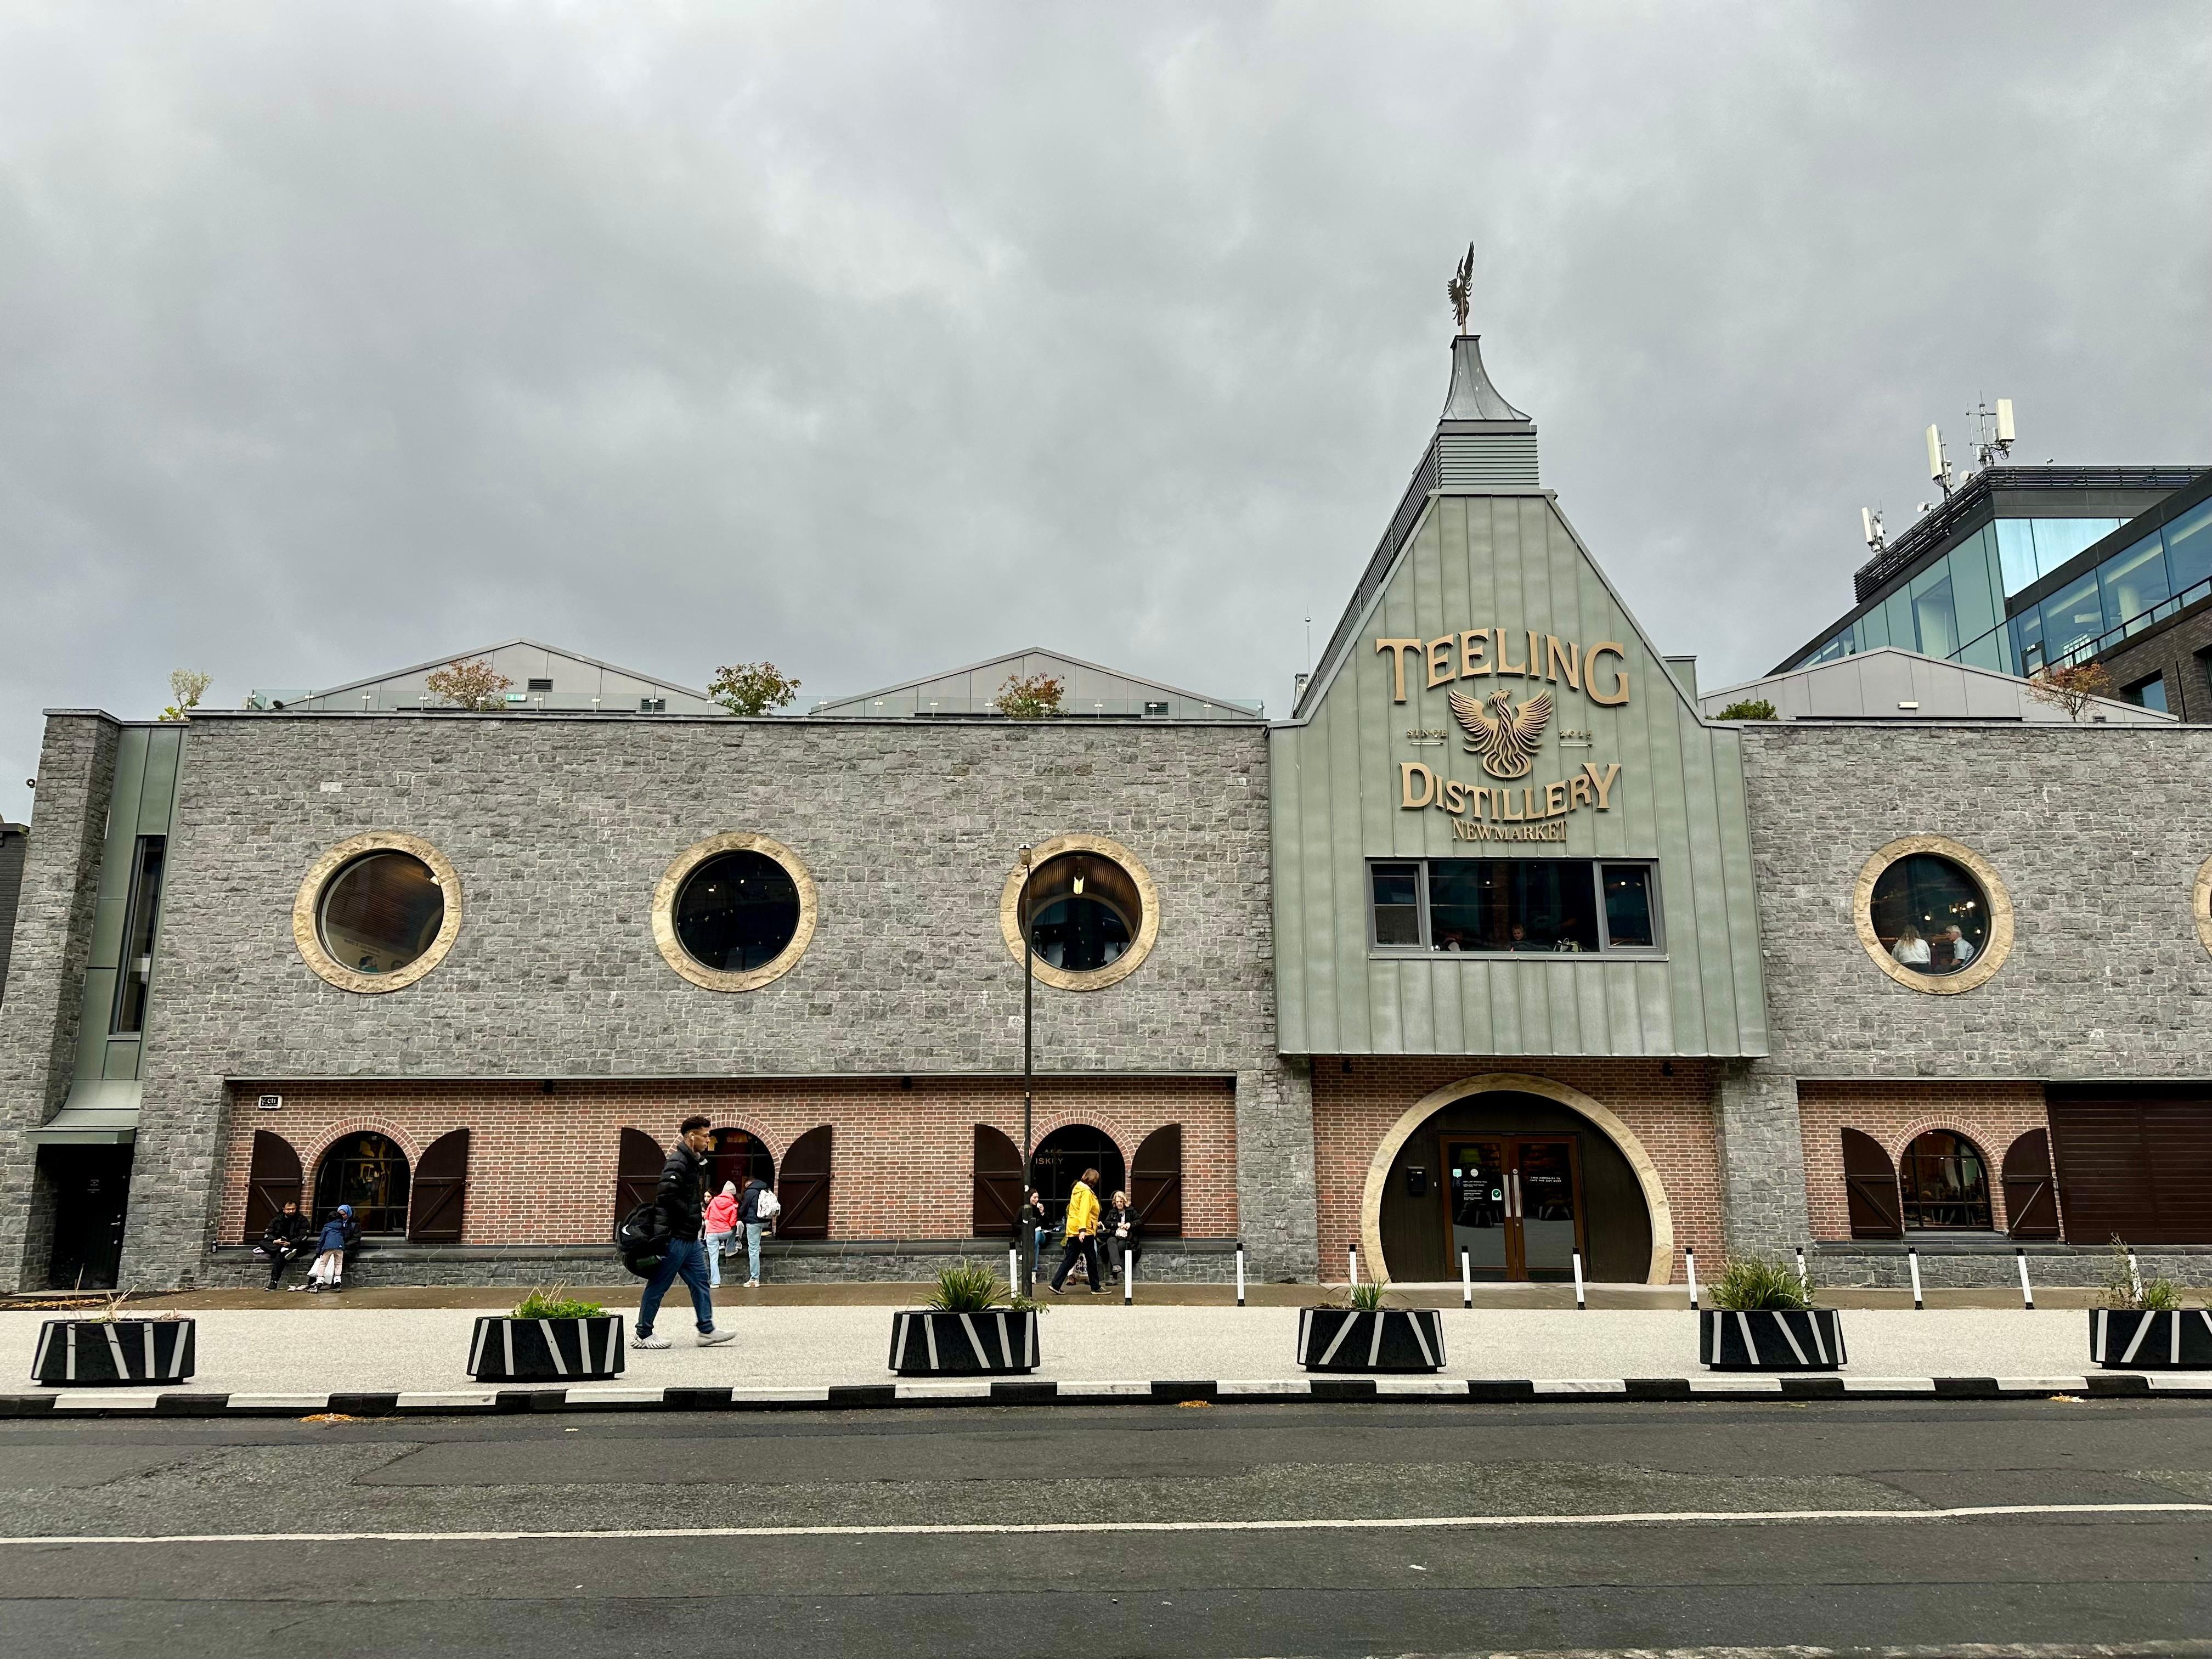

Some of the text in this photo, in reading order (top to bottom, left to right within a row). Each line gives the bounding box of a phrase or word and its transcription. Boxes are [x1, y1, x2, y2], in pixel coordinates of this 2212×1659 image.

[1375, 628, 1630, 706] TEELING
[1407, 729, 1593, 739] SINCE 2015
[1399, 762, 1621, 821] DISTILLERY
[1452, 817, 1567, 842] NEWMARKET
